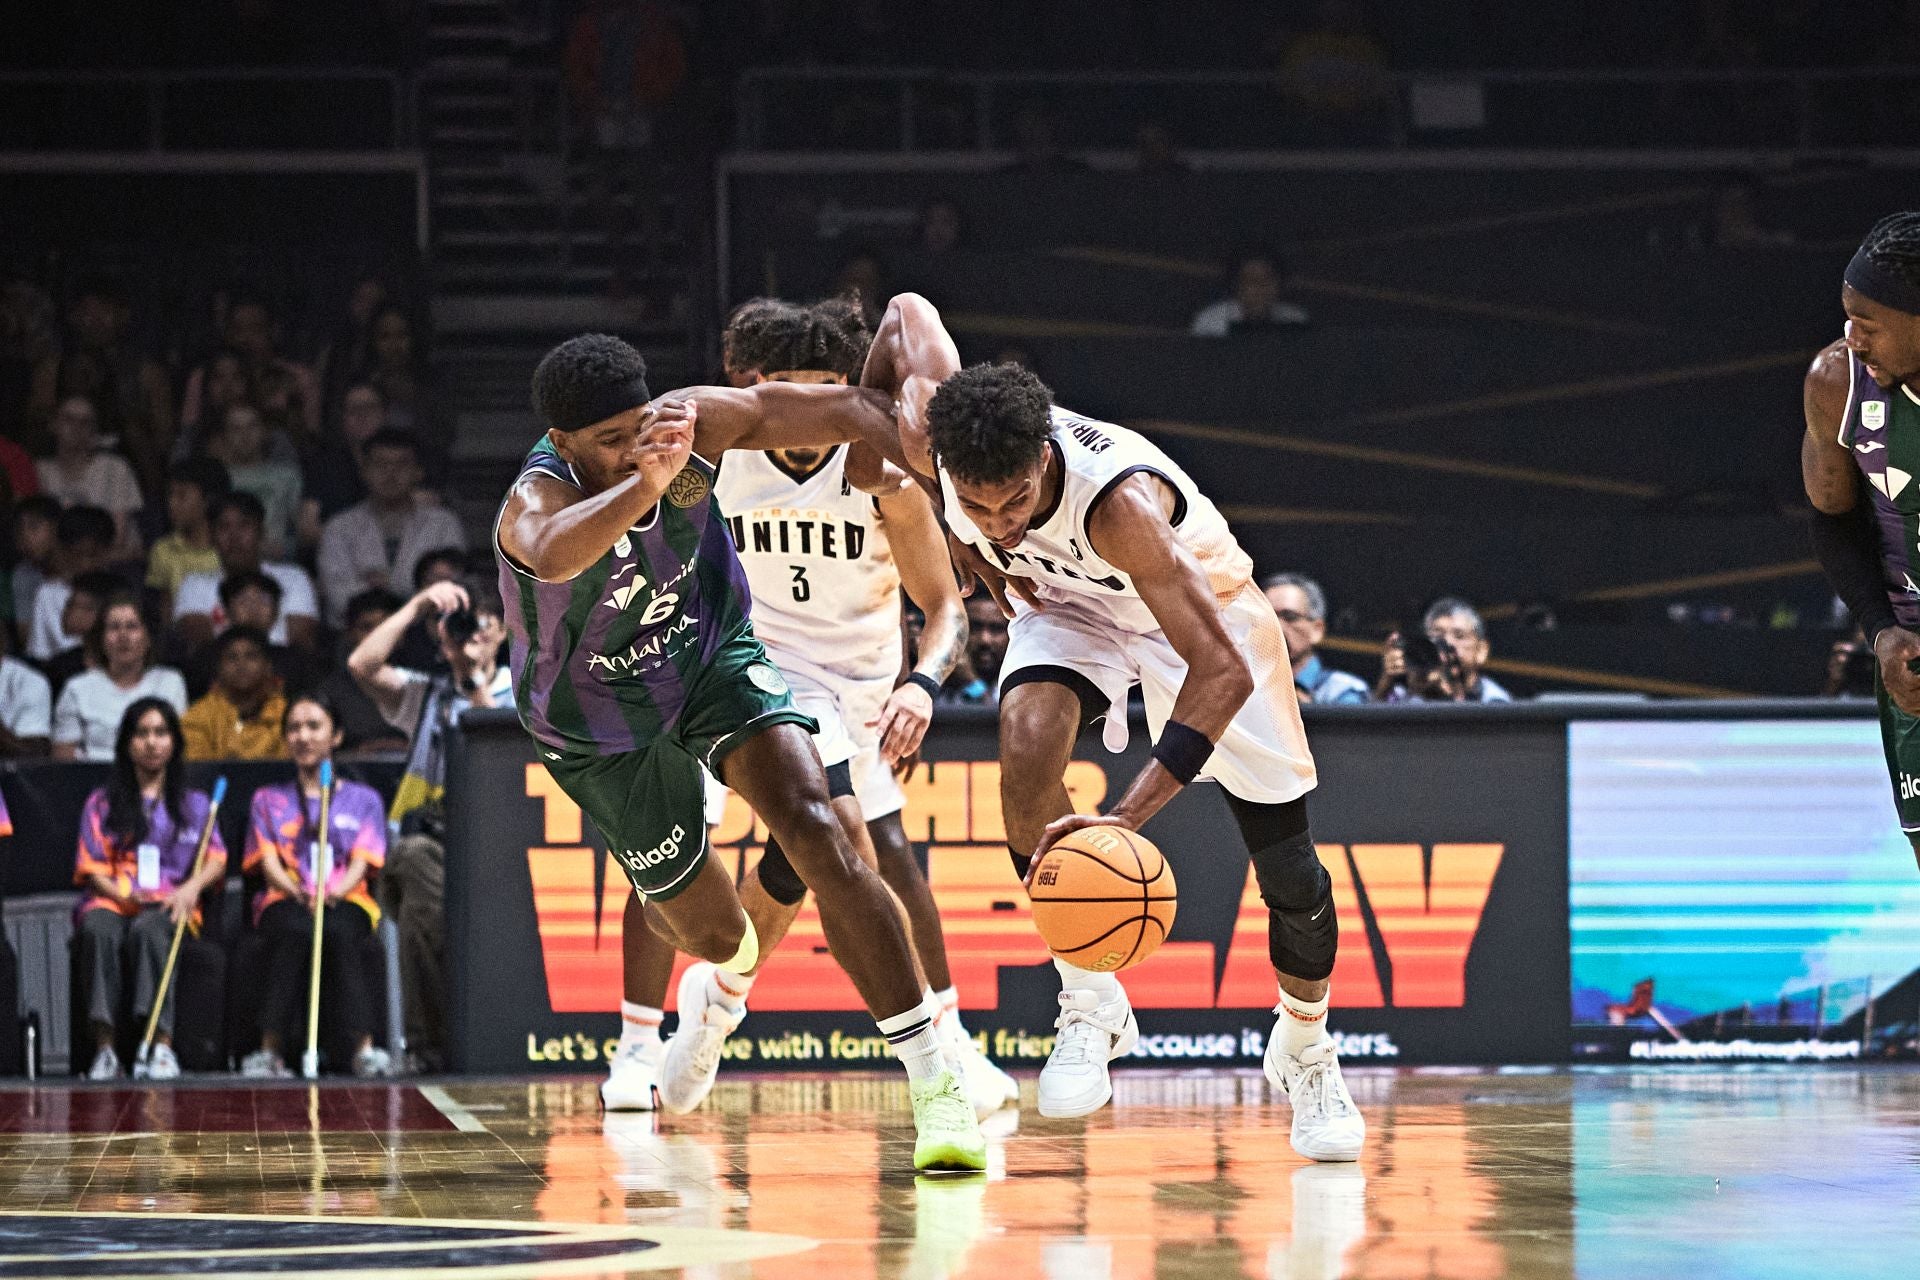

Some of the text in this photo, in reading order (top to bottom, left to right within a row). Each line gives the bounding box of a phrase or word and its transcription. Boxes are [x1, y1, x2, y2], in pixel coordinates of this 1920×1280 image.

[725, 515, 865, 560] UNITED
[789, 565, 810, 602] 3
[639, 592, 680, 625] 6
[620, 824, 686, 871] álaga
[1038, 871, 1059, 886] FIBA
[527, 1031, 599, 1061] Let's
[758, 1030, 824, 1060] with
[829, 1030, 898, 1060] fam
[994, 1028, 1058, 1058] frien
[1131, 1032, 1237, 1057] ecause
[1241, 1027, 1264, 1057] it
[1332, 1032, 1398, 1057] ters.
